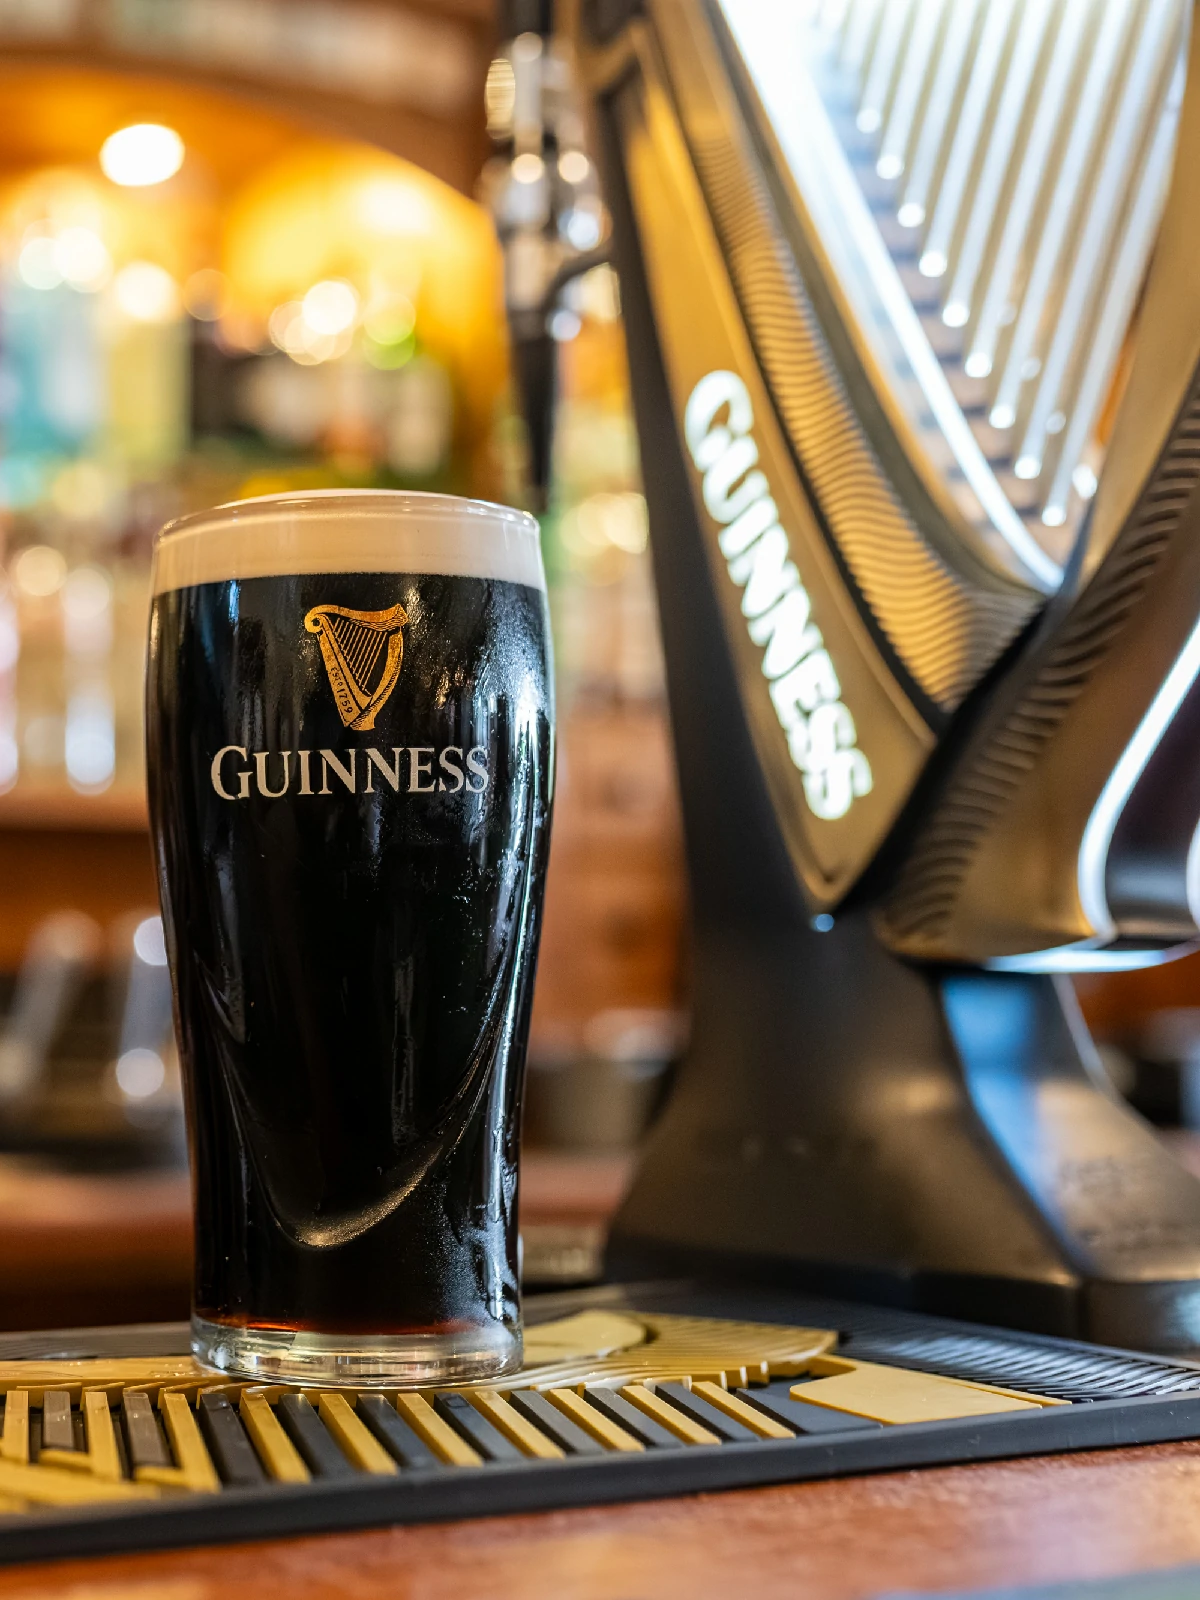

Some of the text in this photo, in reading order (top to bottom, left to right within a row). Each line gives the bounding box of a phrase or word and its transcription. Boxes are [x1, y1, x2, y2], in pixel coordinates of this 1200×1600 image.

[685, 369, 874, 820] GUINNESS
[337, 688, 354, 714] 1759
[211, 745, 490, 801] GUINNESS
